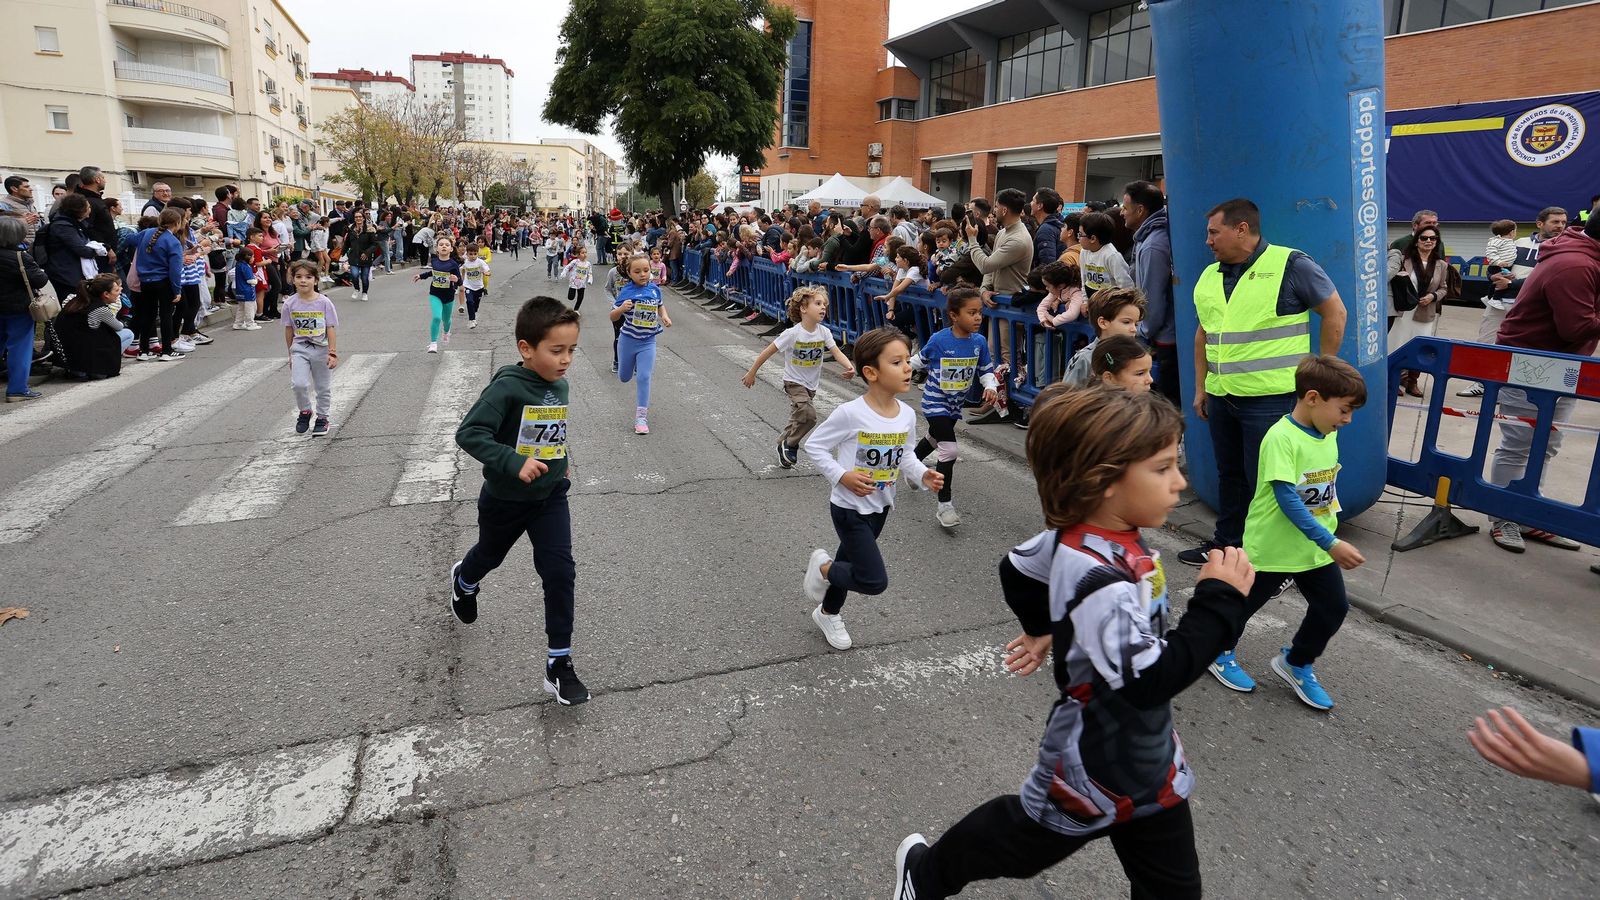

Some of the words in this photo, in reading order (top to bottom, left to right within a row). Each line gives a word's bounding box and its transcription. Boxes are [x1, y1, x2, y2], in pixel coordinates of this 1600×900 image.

[1516, 109, 1548, 132] BOMBEROS
[1564, 112, 1580, 141] PROVINCIA
[1511, 140, 1536, 162] CONSORCIO
[1564, 141, 1574, 151] DE
[1357, 95, 1381, 355] deportes@aytojerez.es
[798, 348, 823, 360] 512
[947, 367, 974, 380] 719
[534, 423, 567, 443] 723
[866, 447, 904, 467] 918
